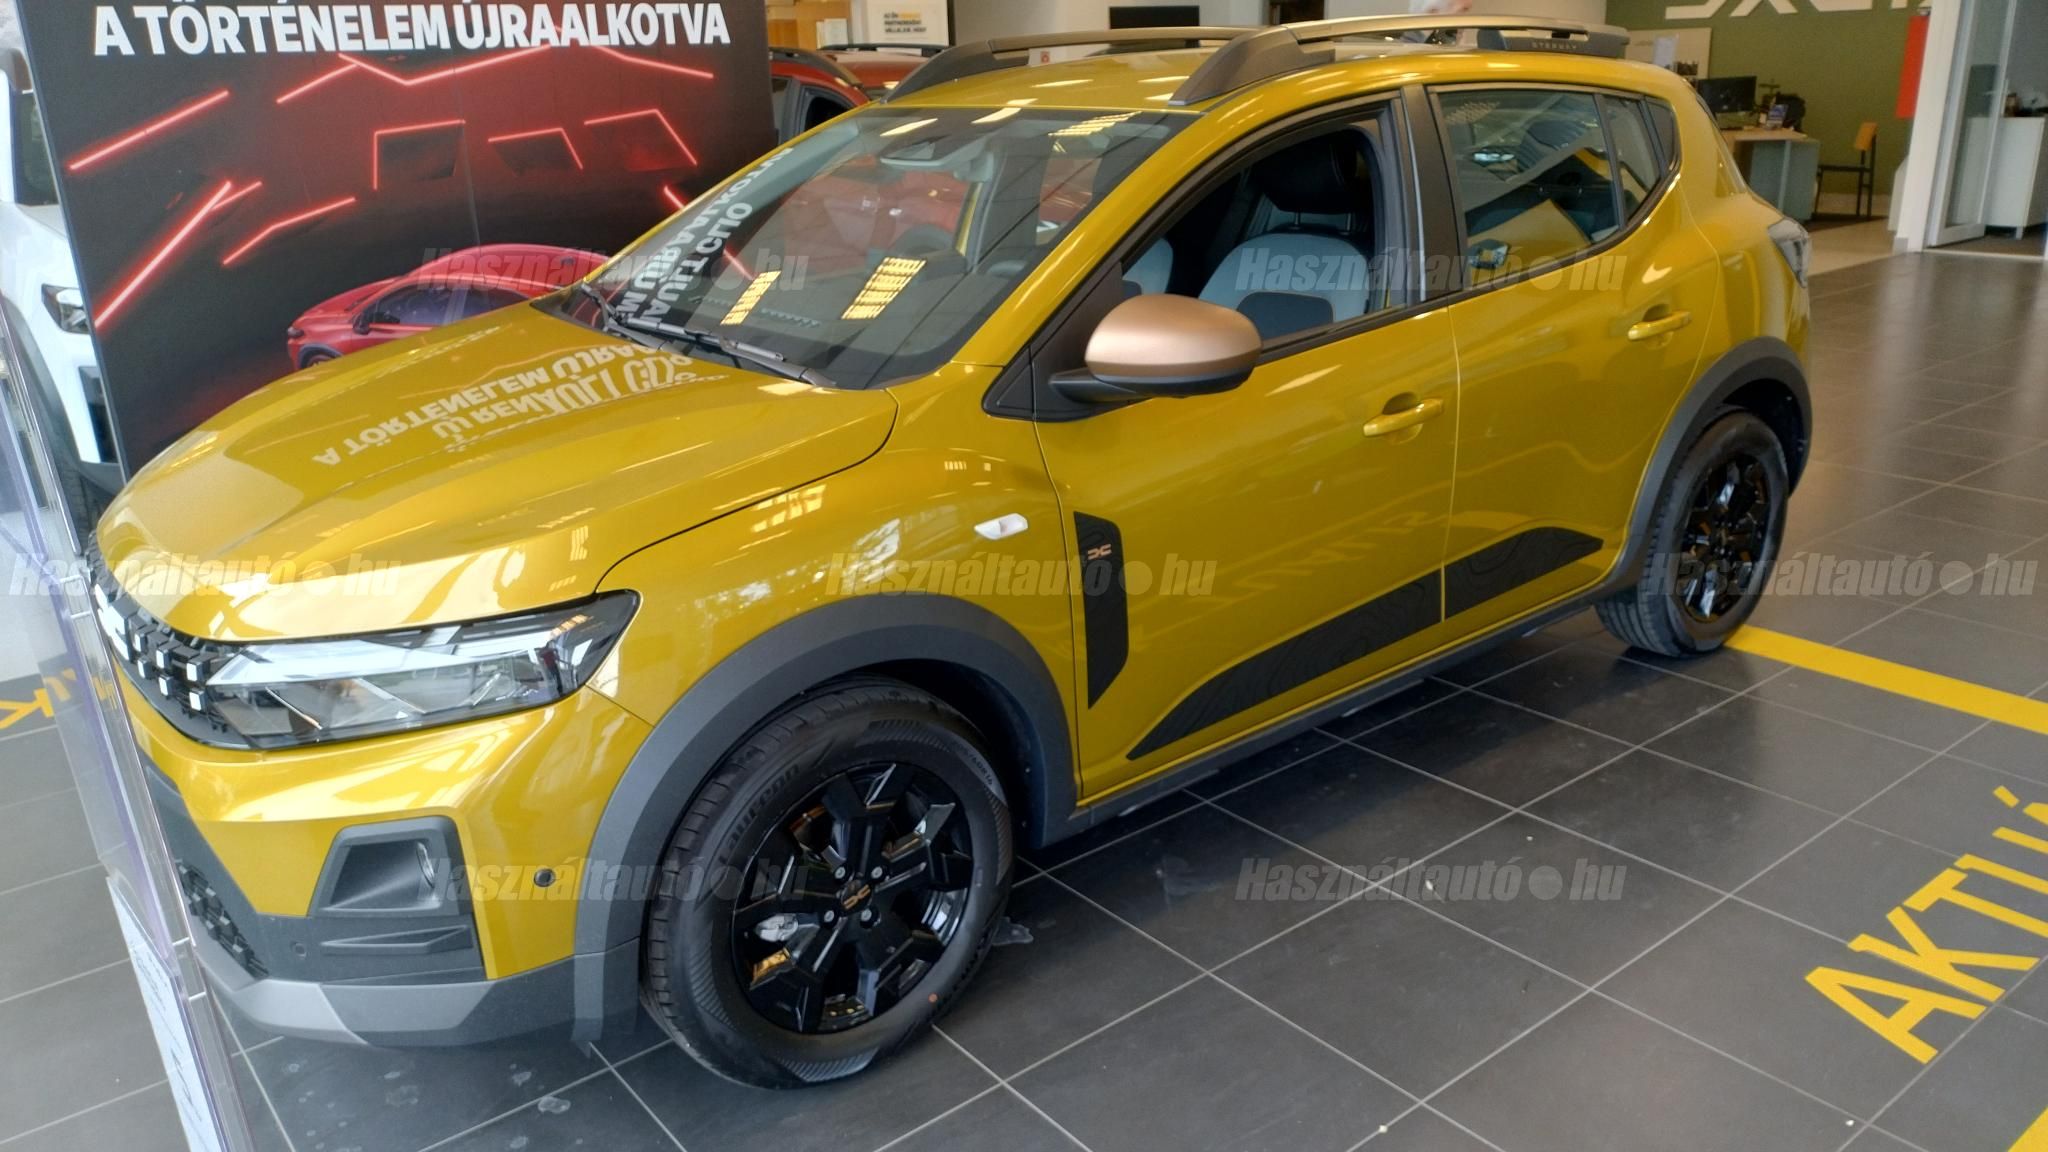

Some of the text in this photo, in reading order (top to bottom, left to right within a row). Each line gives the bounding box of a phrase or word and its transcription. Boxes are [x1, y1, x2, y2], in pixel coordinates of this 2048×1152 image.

[94, 0, 731, 56] A TÖRTÉNELEM ÚJRAALKOTVA
